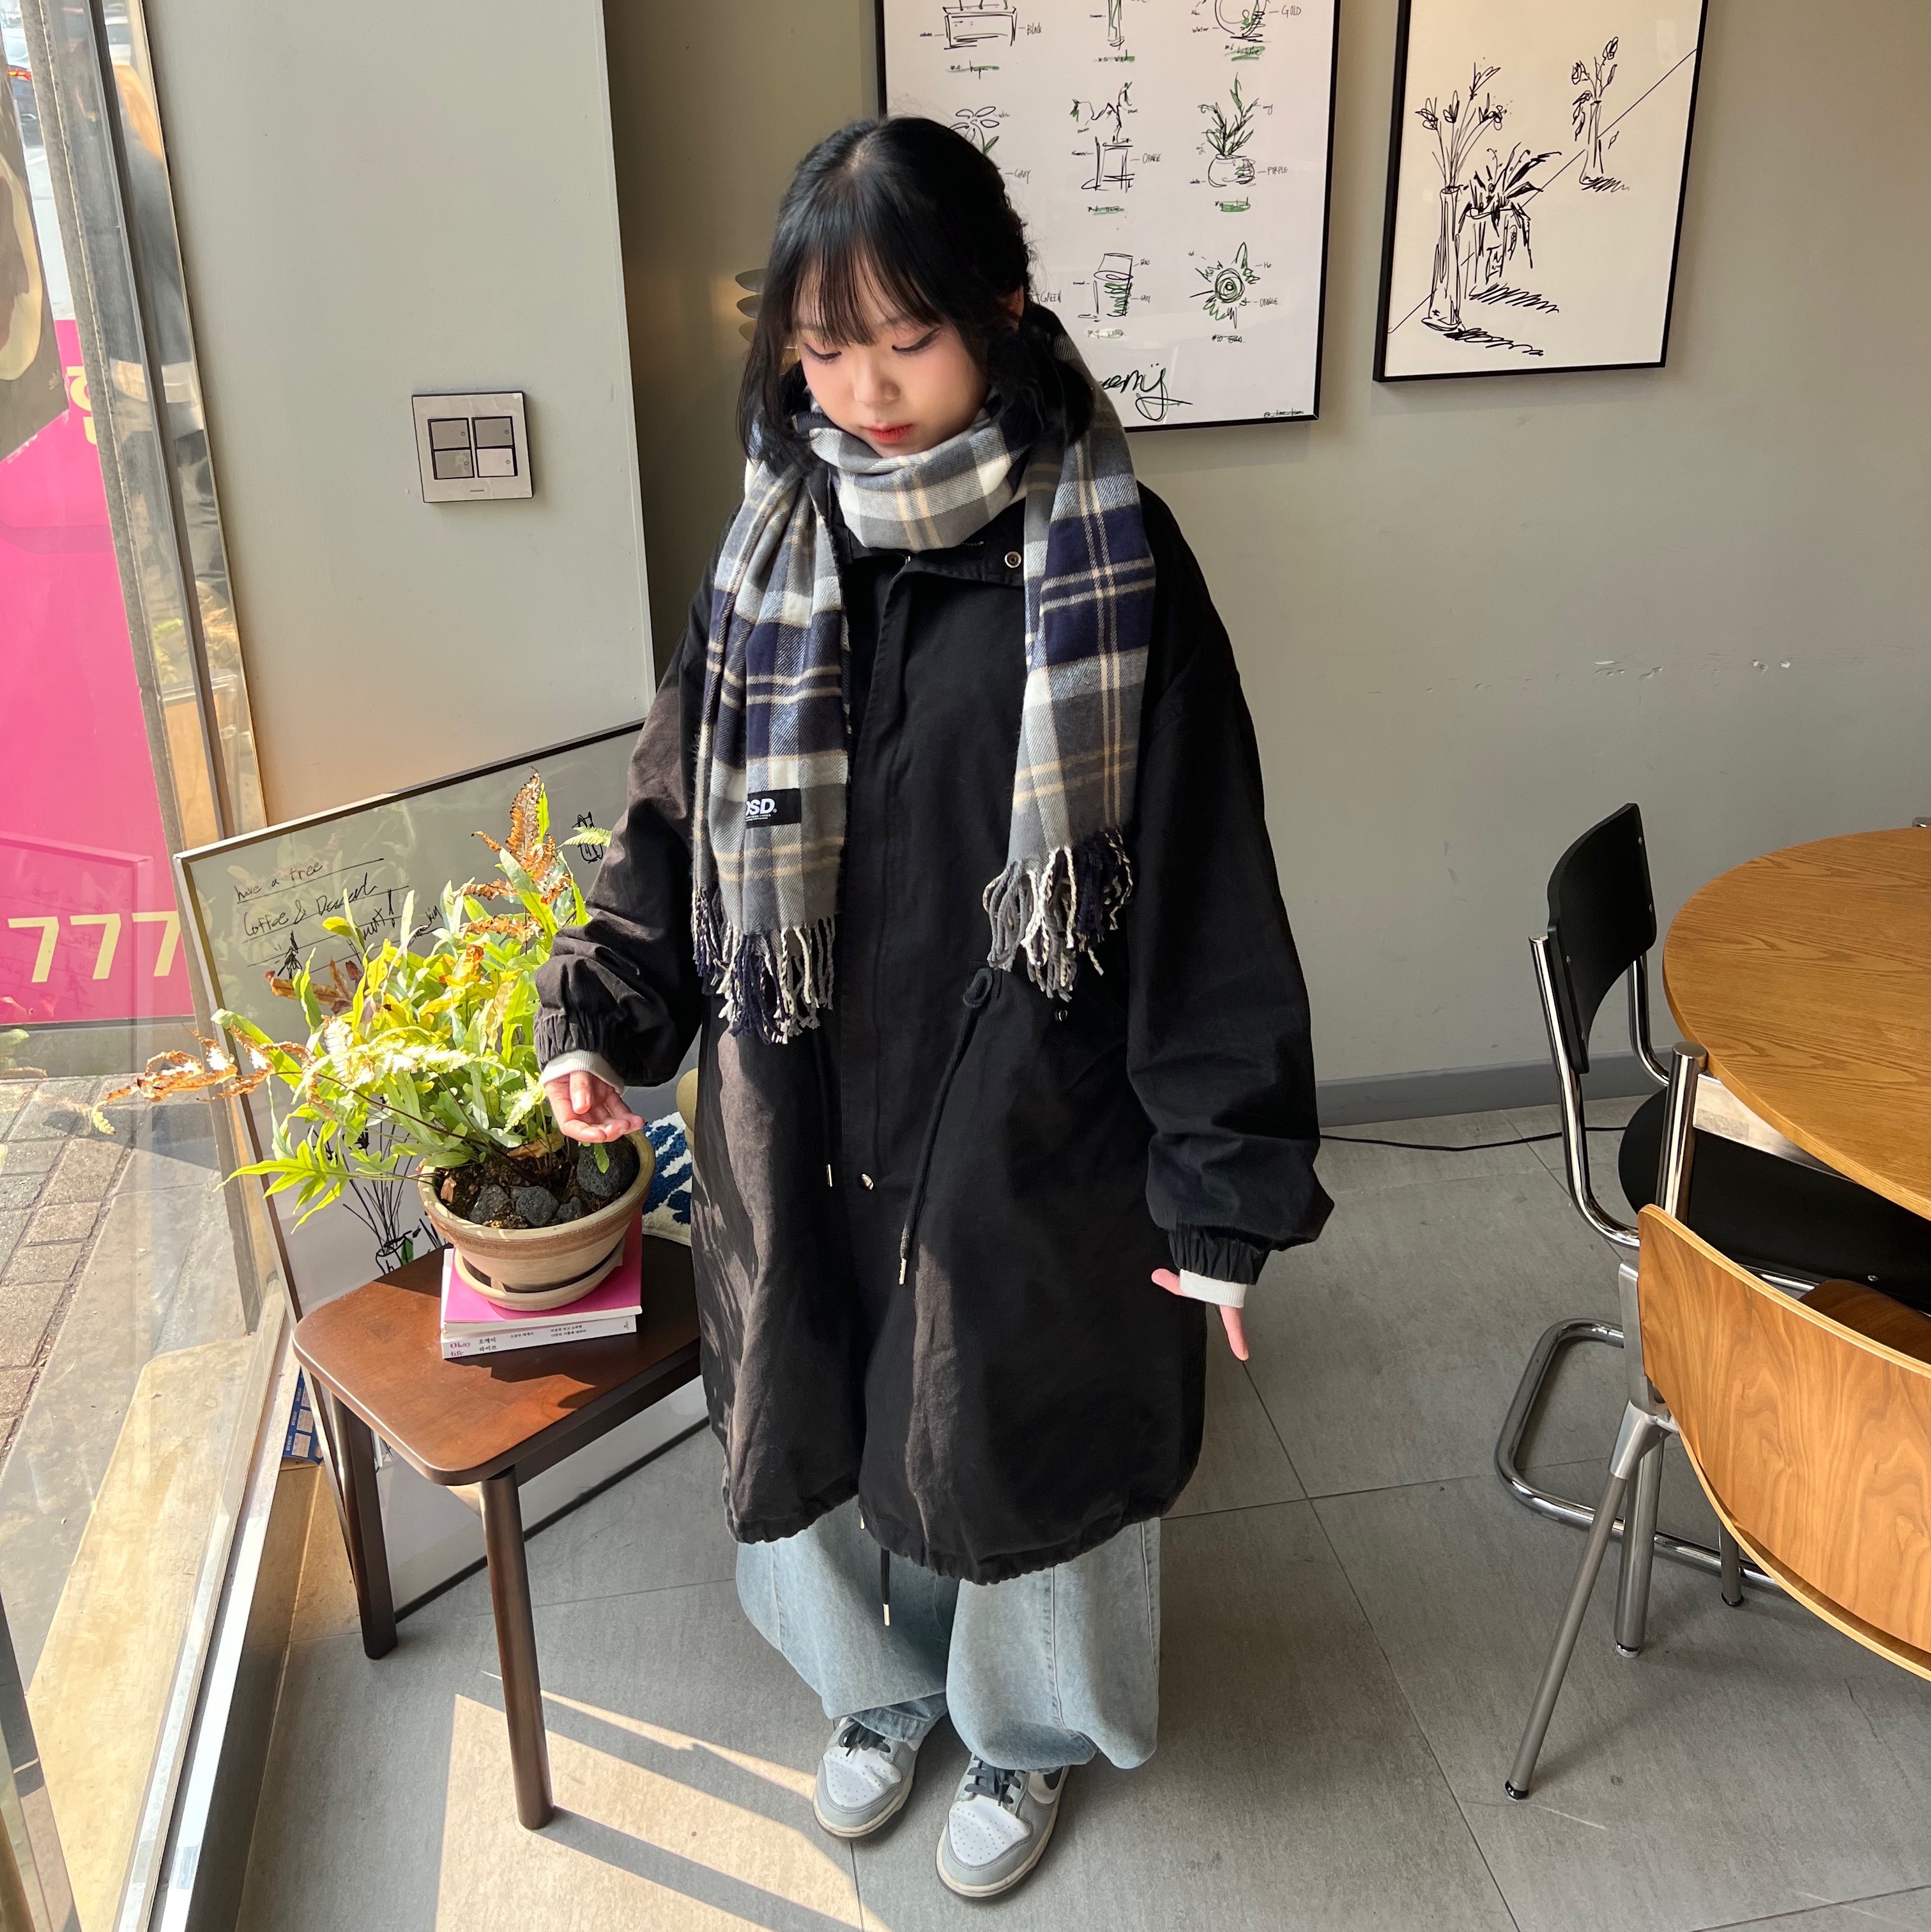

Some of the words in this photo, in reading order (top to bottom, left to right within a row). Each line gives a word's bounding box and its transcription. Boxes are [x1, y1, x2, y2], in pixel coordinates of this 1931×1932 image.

[1281, 4, 1302, 18] GOLD
[234, 885, 261, 901] have
[271, 878, 280, 887] a
[289, 862, 323, 881] tree
